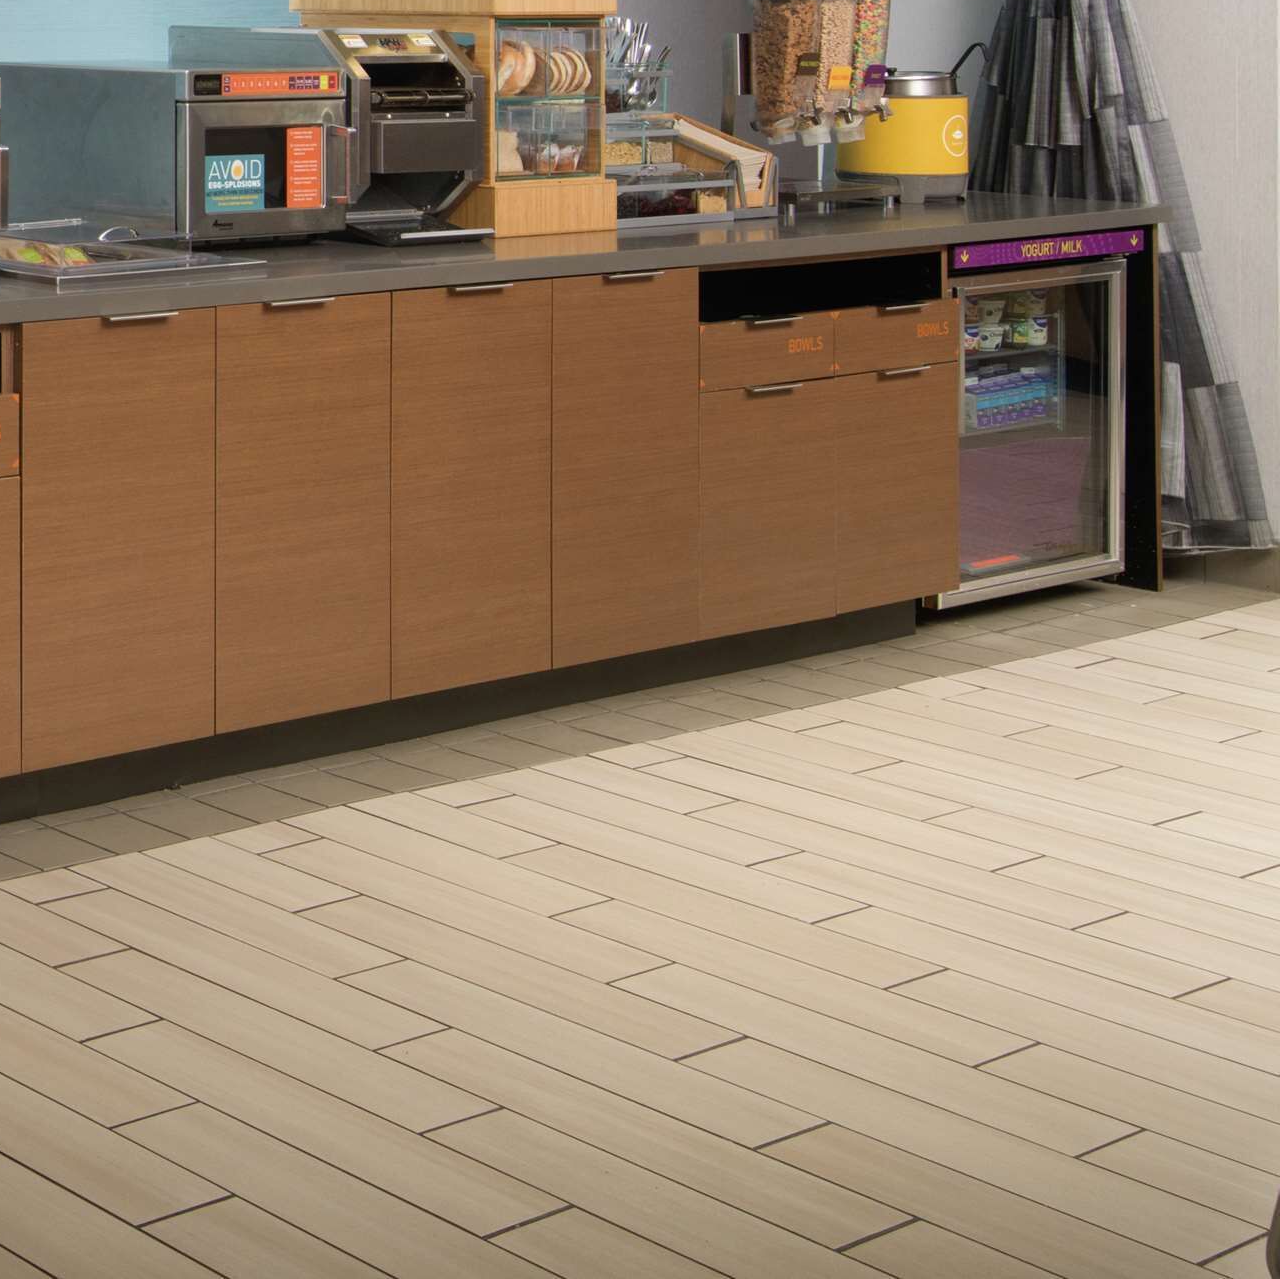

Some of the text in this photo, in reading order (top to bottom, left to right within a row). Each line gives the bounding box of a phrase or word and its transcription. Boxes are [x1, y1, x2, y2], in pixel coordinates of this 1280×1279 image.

[208, 159, 262, 180] AVOID
[1020, 241, 1055, 257] YOGURT
[1061, 240, 1083, 254] MILK
[916, 321, 950, 337] BOWLS
[787, 336, 823, 353] BOWLS
